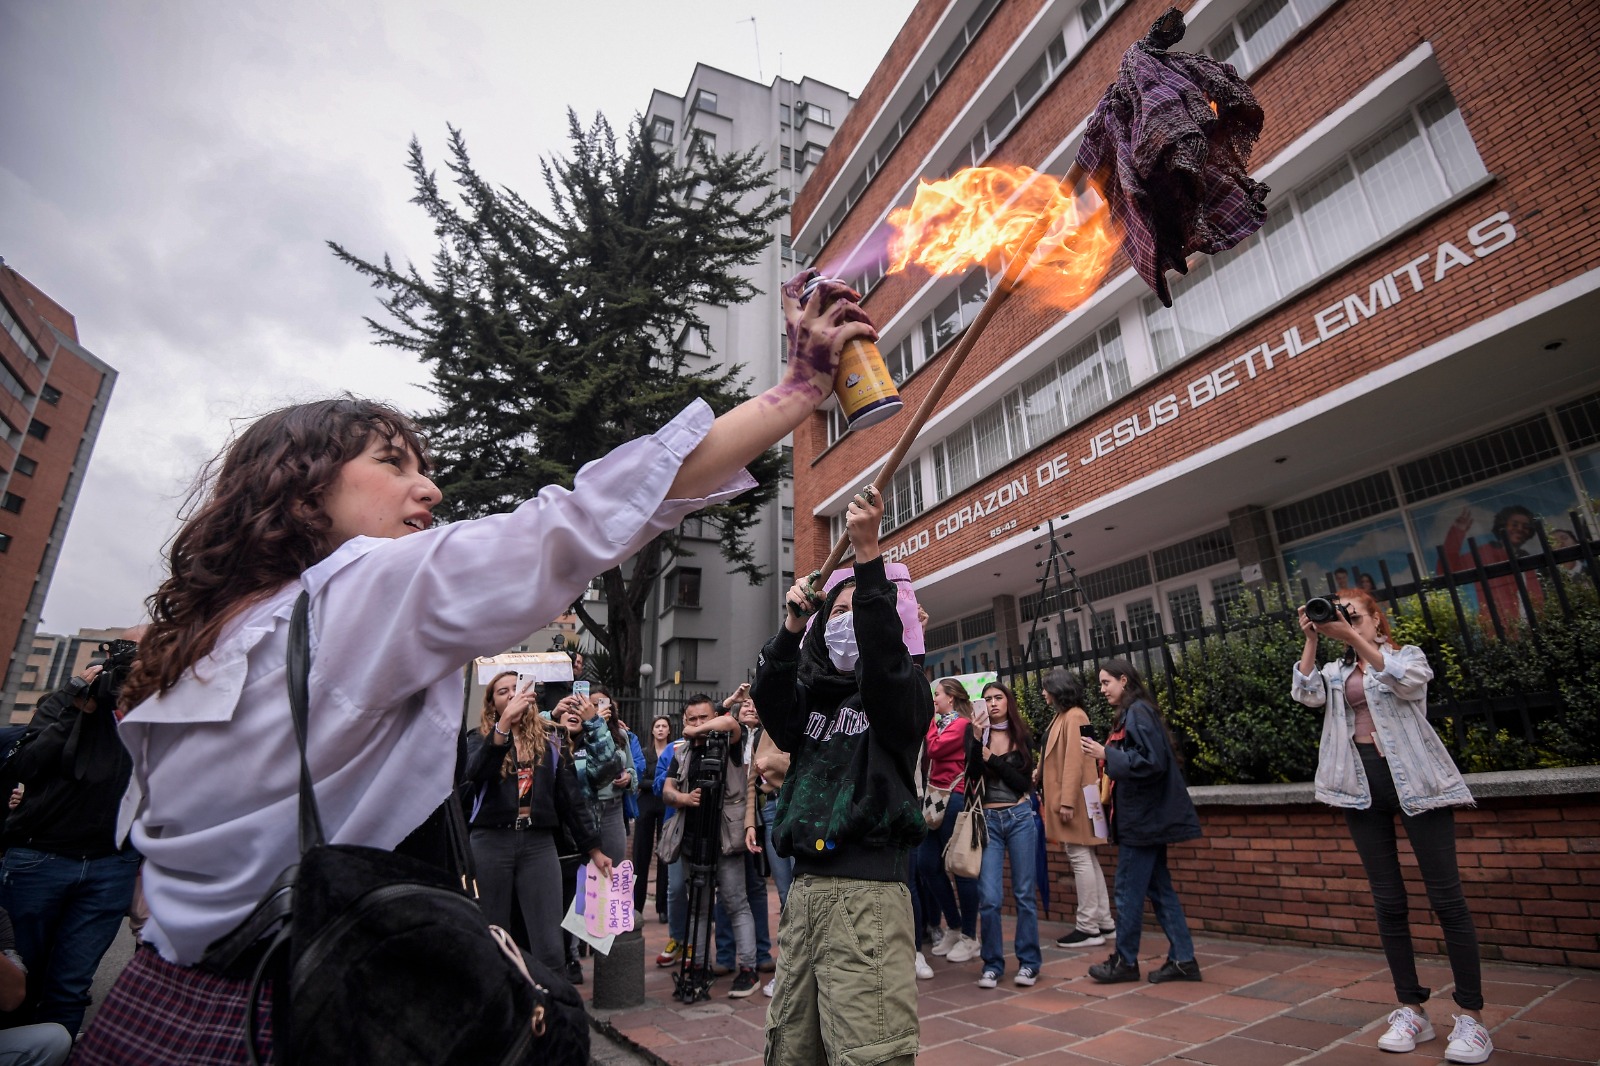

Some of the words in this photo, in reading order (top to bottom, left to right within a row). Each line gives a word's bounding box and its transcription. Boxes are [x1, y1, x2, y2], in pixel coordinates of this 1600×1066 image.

[881, 529, 930, 563] GRADO
[935, 474, 1028, 541] CORAZON
[1036, 452, 1070, 488] DE
[622, 862, 633, 894] Juntas
